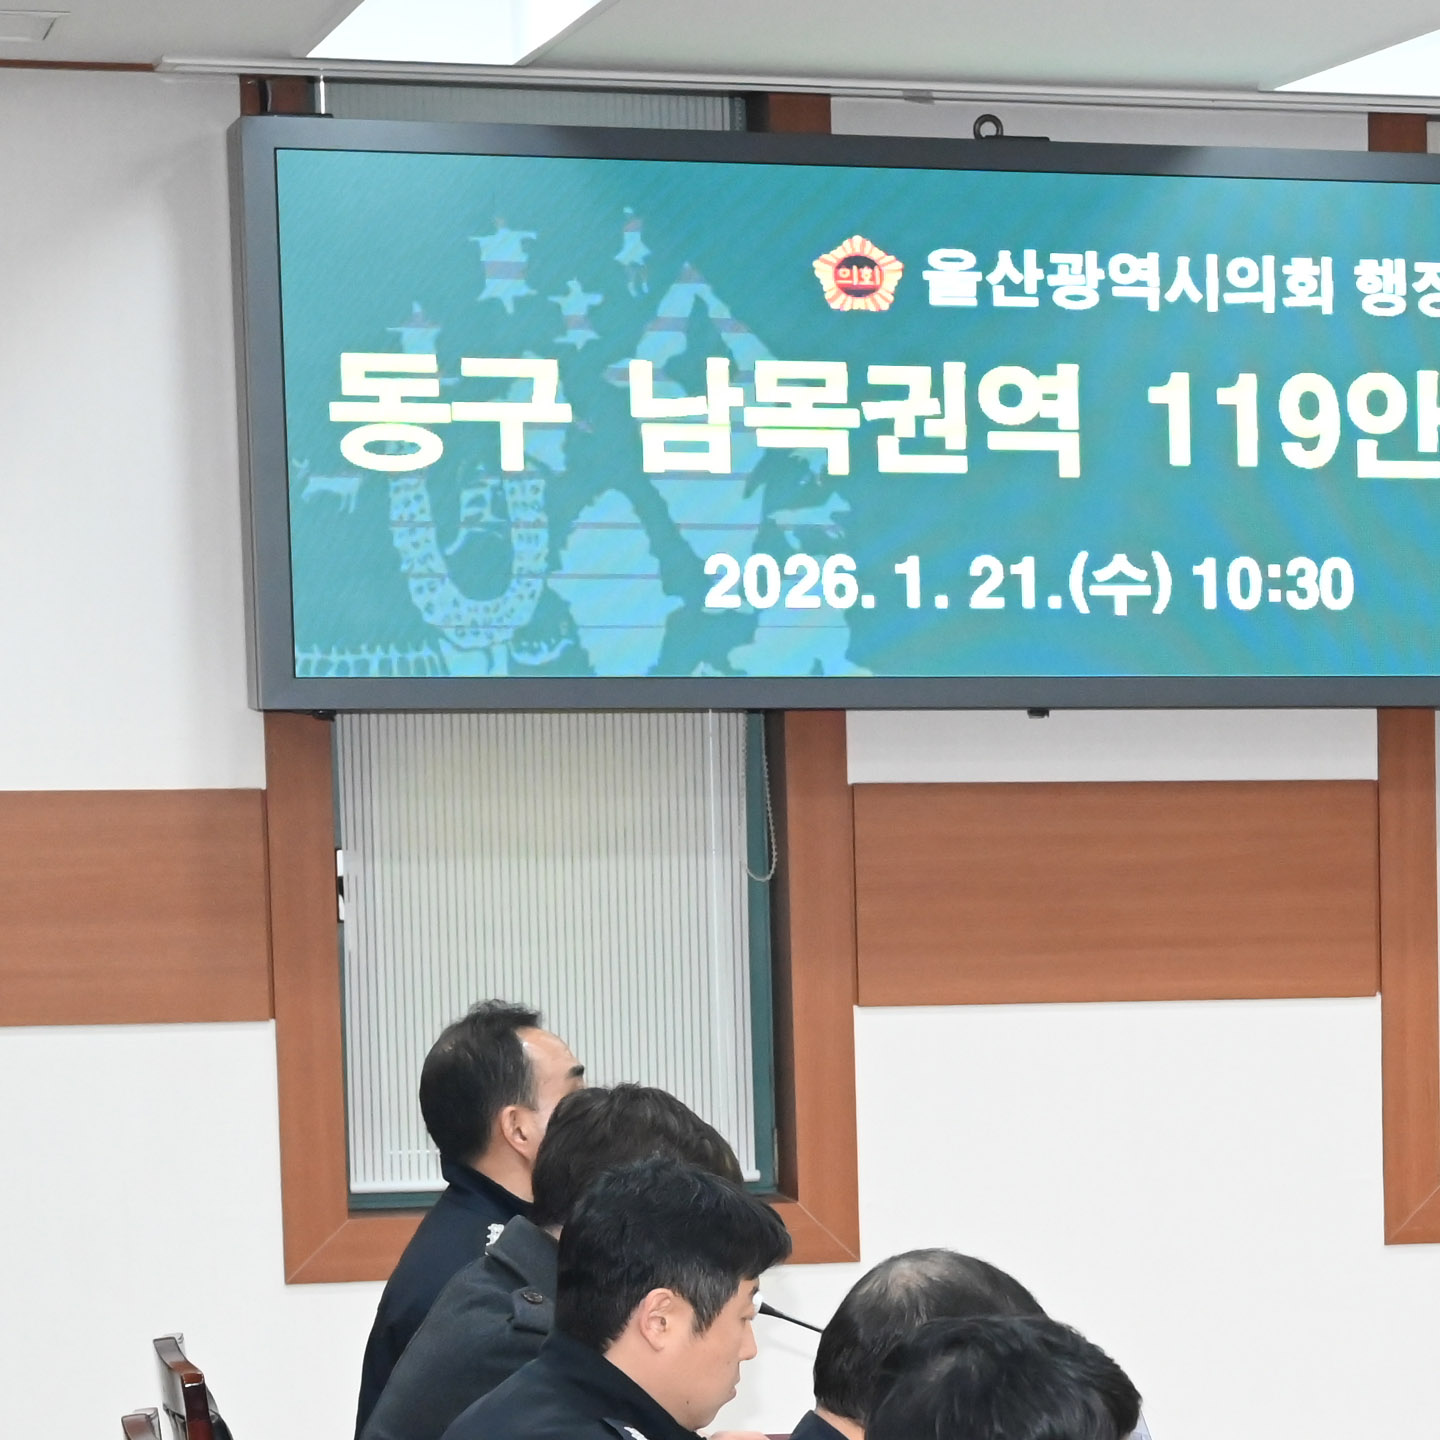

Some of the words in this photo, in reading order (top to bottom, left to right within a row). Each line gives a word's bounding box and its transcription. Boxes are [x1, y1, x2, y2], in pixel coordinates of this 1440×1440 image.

[922, 248, 1334, 315] 울산광역시의회
[329, 352, 573, 473] 동구
[628, 357, 1081, 479] 남목권역
[704, 552, 875, 609] 2026.
[894, 555, 949, 609] 1.
[968, 550, 1173, 616] 21.(수)
[1192, 555, 1355, 611] 10:30
